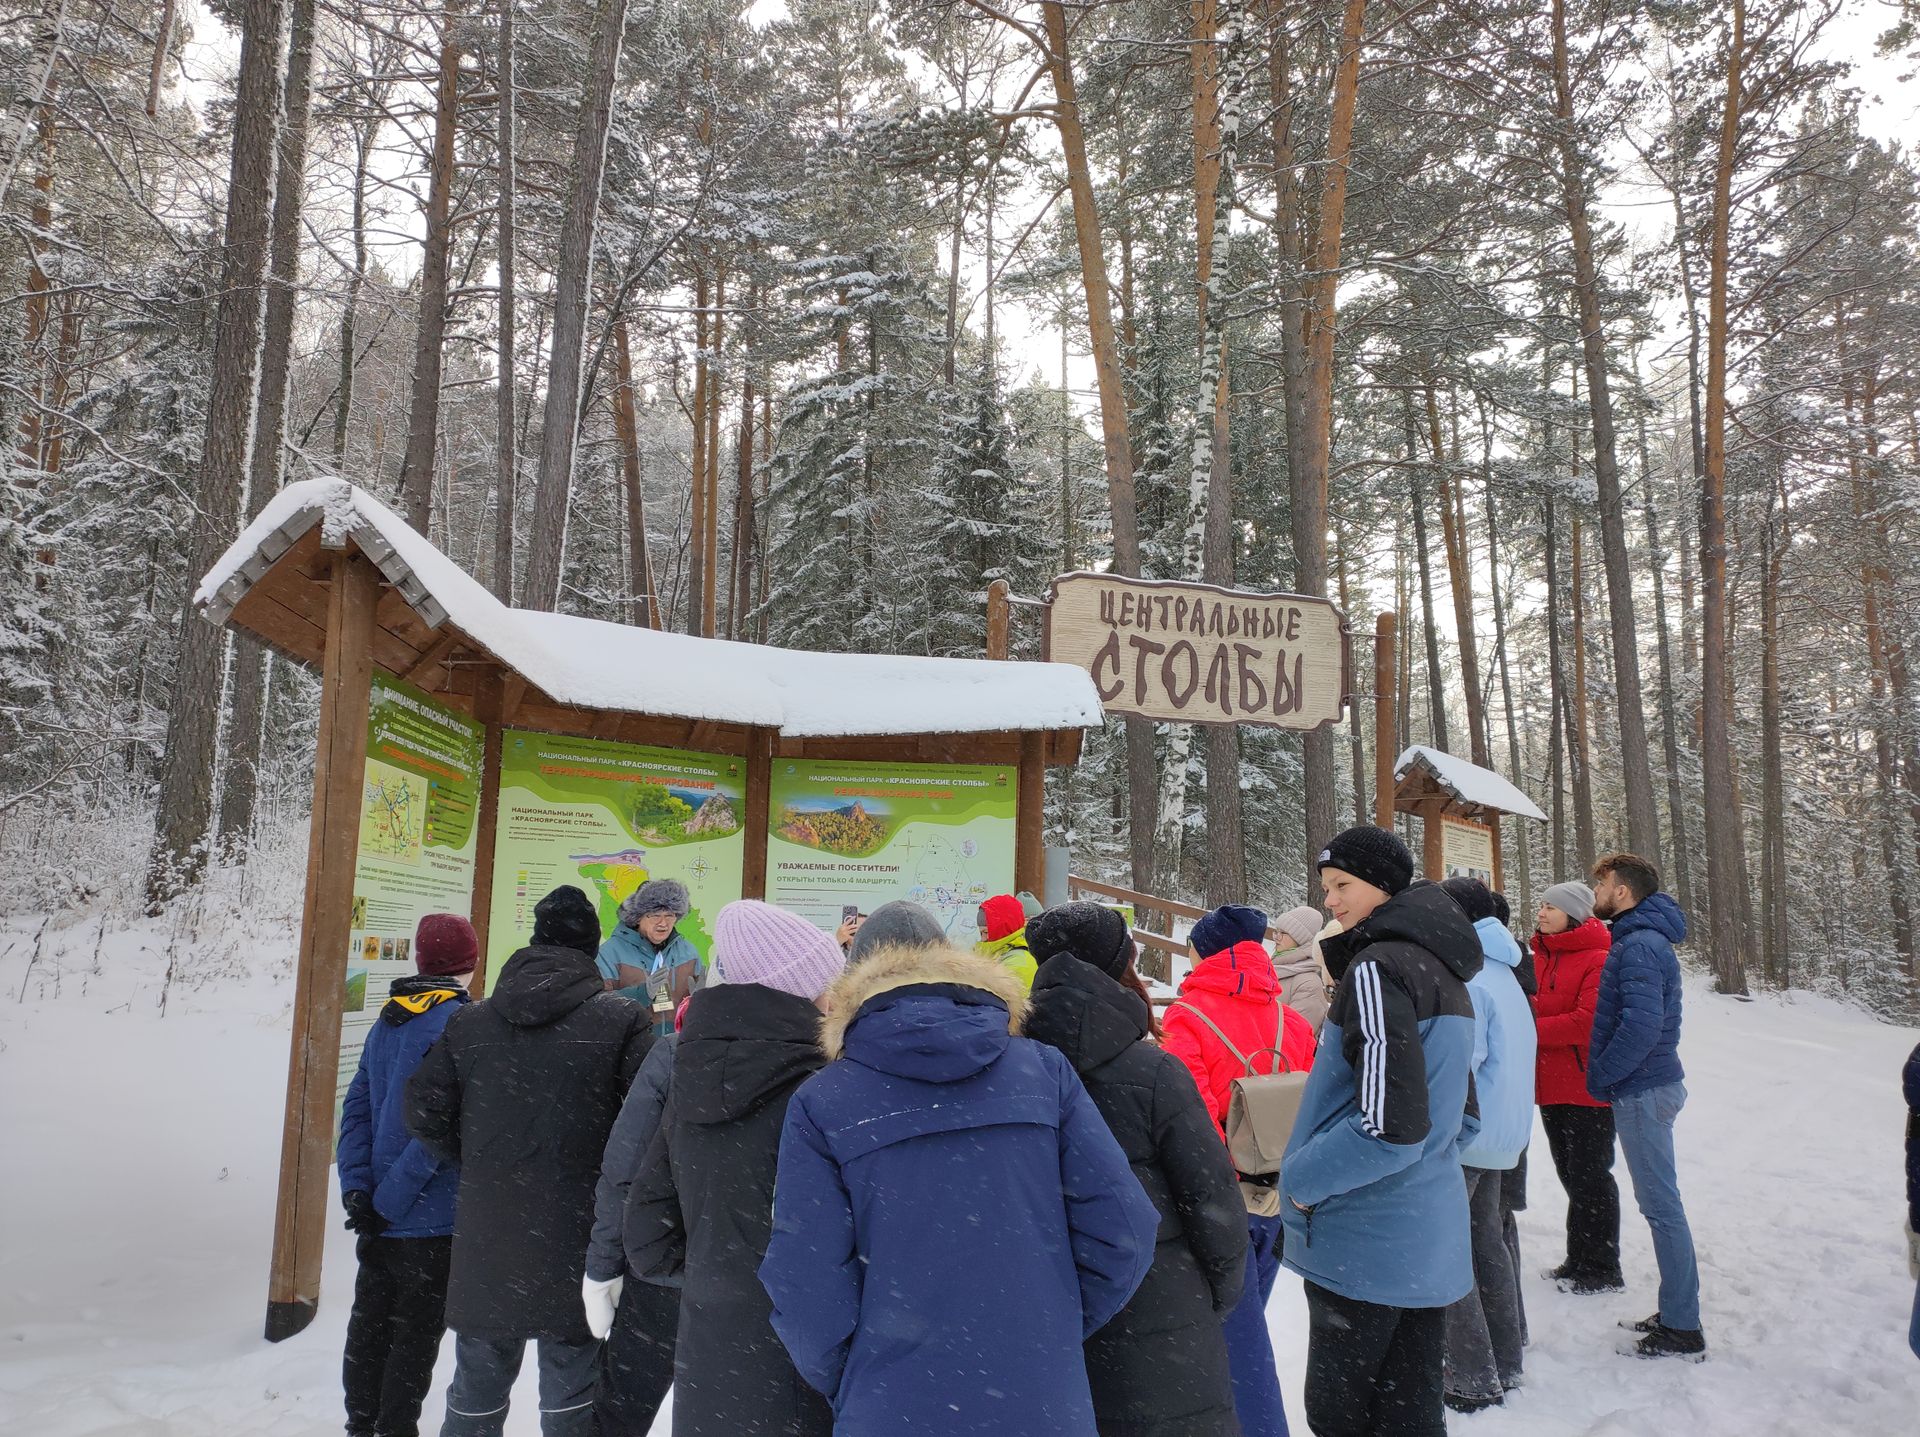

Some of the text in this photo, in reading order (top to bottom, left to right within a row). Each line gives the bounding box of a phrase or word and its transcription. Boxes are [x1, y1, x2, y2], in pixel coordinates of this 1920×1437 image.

[1100, 589, 1303, 641] ЦЕНТРАЛЬНЫЕ
[1090, 630, 1303, 716] СТОЛБЫ
[420, 704, 449, 727] ОПАСНЫЙ
[538, 752, 598, 763] НАЦИОНАЛЬНЫЙ
[598, 758, 617, 766] ПАРК
[618, 760, 682, 773] «КРАСНОЯРСКИЕ
[683, 767, 719, 777] СТОЛБЫ»
[645, 775, 716, 791] ЗОНИРОВАНИЕ
[809, 775, 865, 783] НАЦИОНАЛЬНЫЙ
[886, 777, 951, 786] «КРАСНОЯРСКИЕ
[952, 779, 989, 787] СТОЛБЫ»
[511, 807, 594, 819] НАЦИОНАЛЬНЫЙ ПАРК
[511, 816, 572, 825] «КРАСНОЯРСКИЕ
[777, 862, 900, 873] УВАЖАЕМЫЕ ПОСЕТИТЕЛИ!
